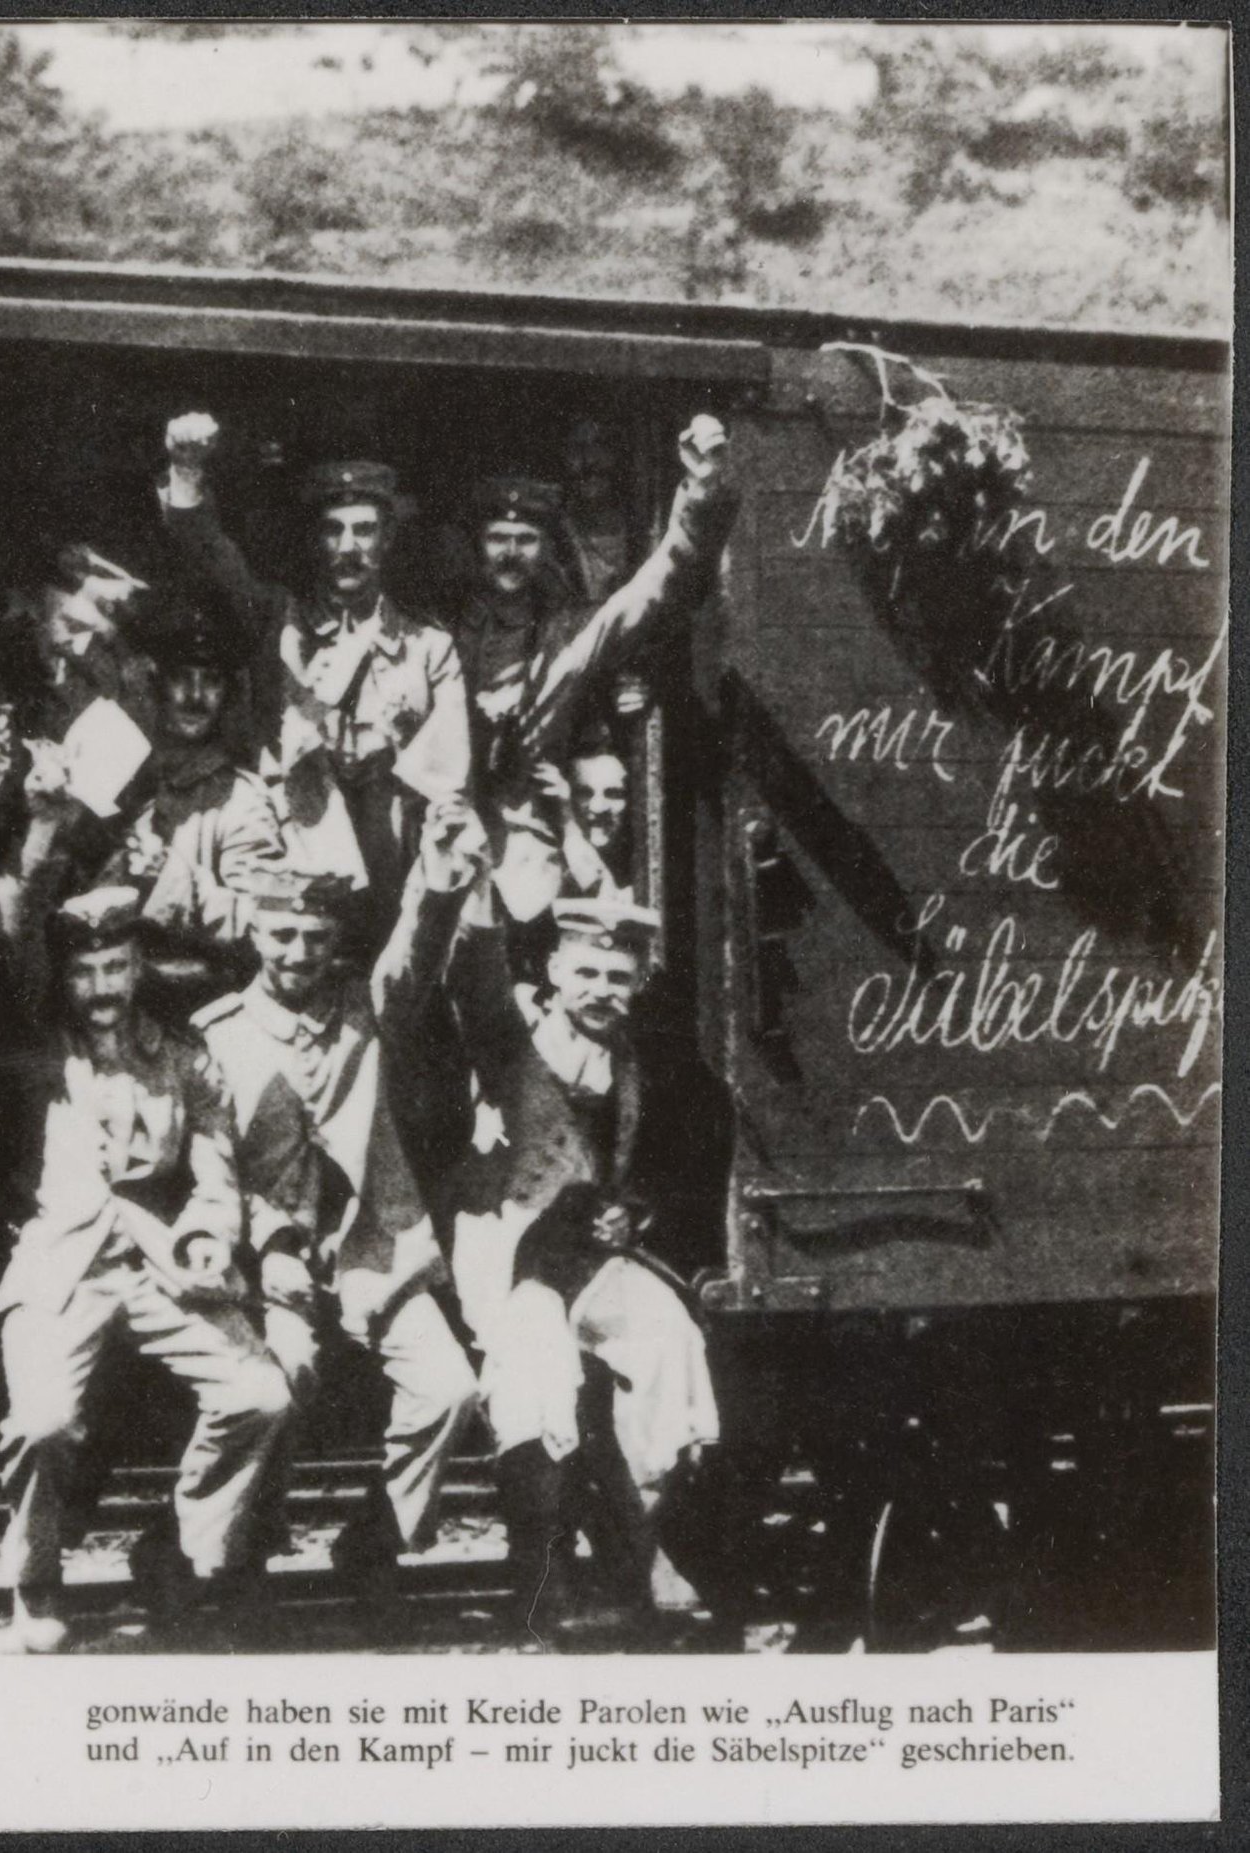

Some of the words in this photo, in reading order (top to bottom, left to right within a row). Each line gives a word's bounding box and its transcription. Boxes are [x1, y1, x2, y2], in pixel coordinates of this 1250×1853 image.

[1087, 456, 1209, 567] den
[815, 686, 954, 781] mir
[960, 803, 1059, 889] die
[849, 894, 1224, 1078] Säbelspitz
